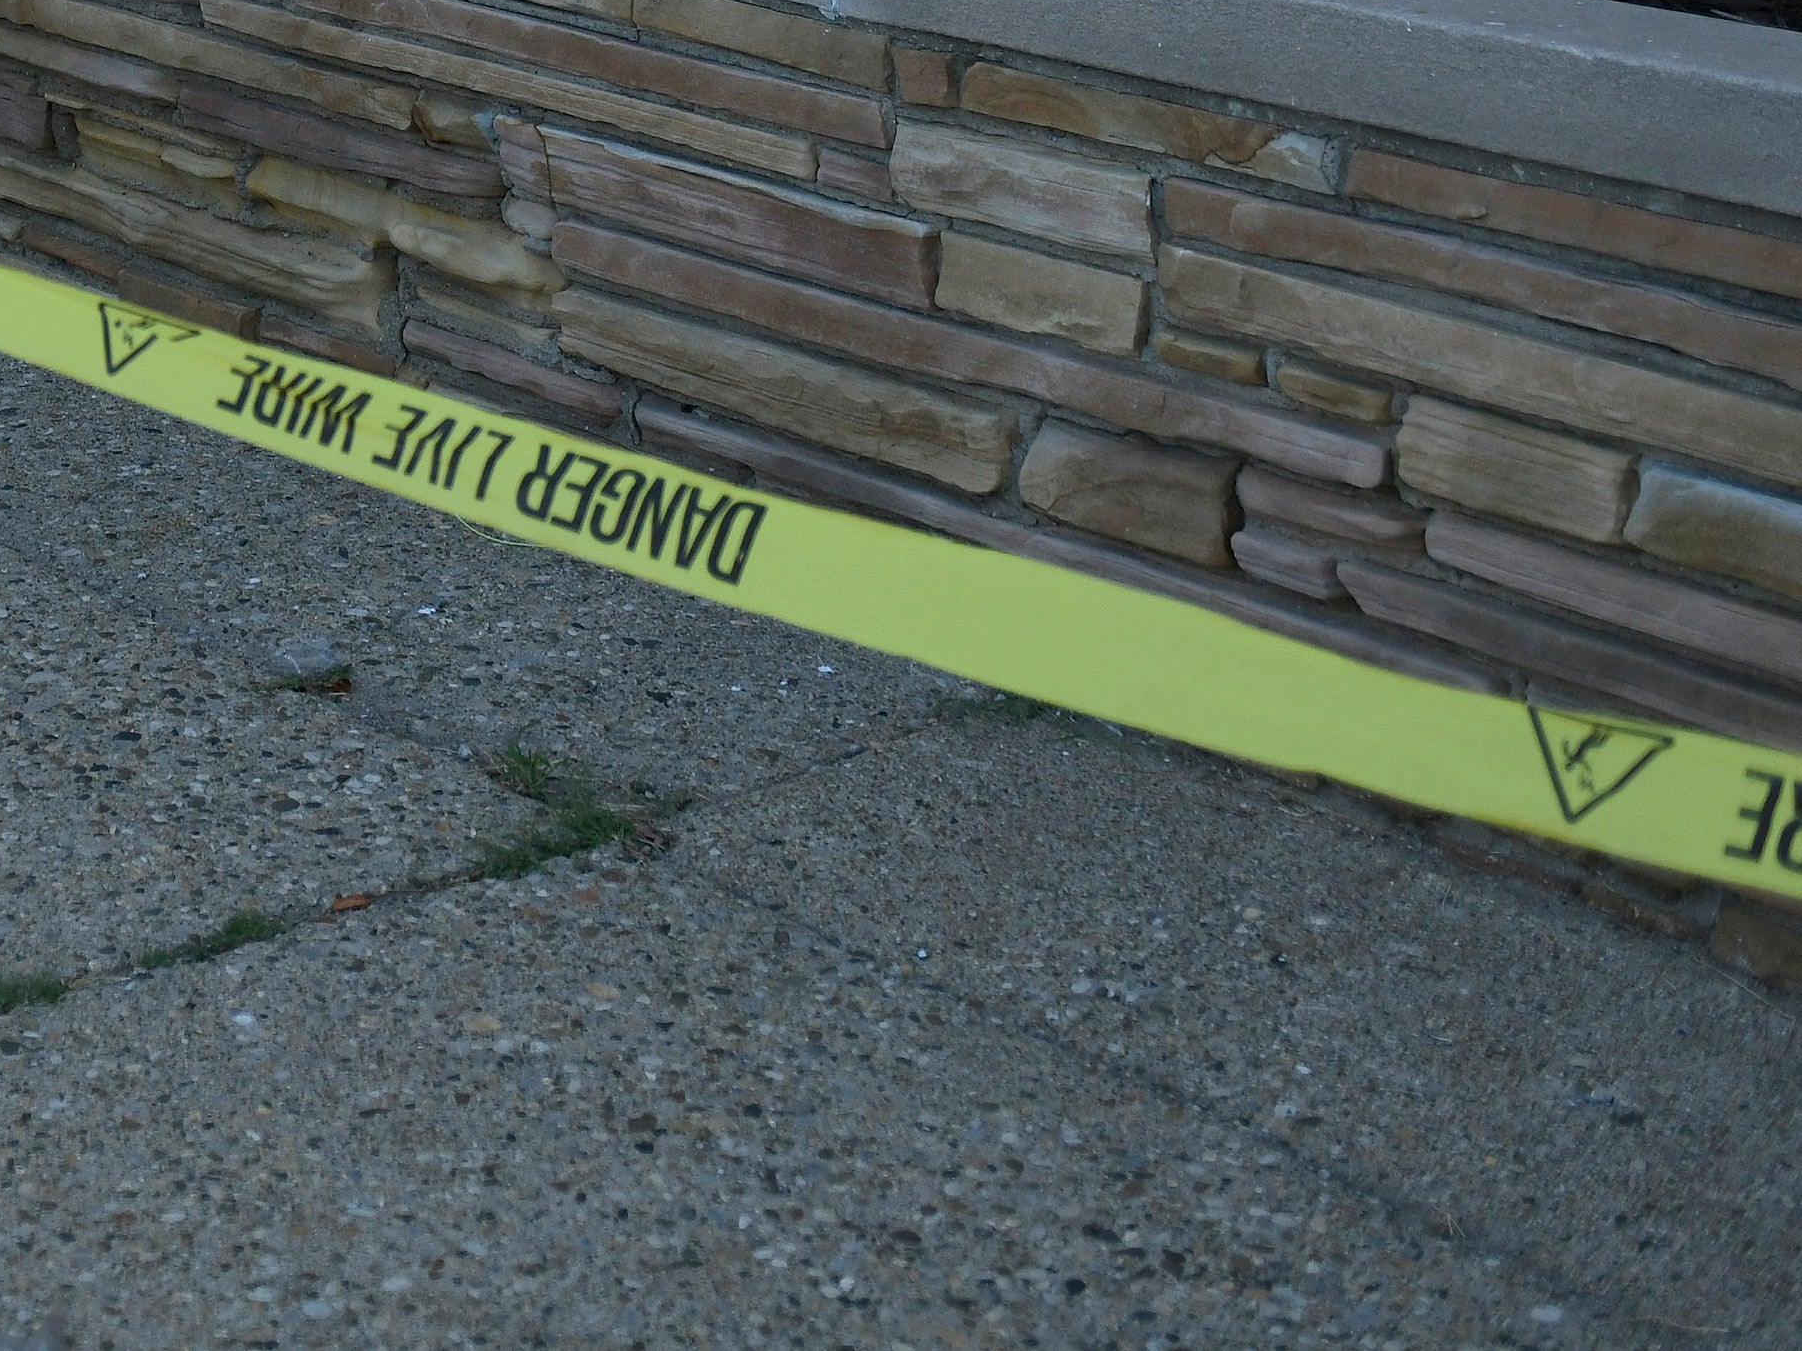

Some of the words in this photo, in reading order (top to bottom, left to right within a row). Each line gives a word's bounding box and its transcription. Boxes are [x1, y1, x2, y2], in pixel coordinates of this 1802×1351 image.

[216, 353, 375, 454] WIRE
[371, 404, 514, 501] LIVE
[515, 443, 769, 586] DANGER
